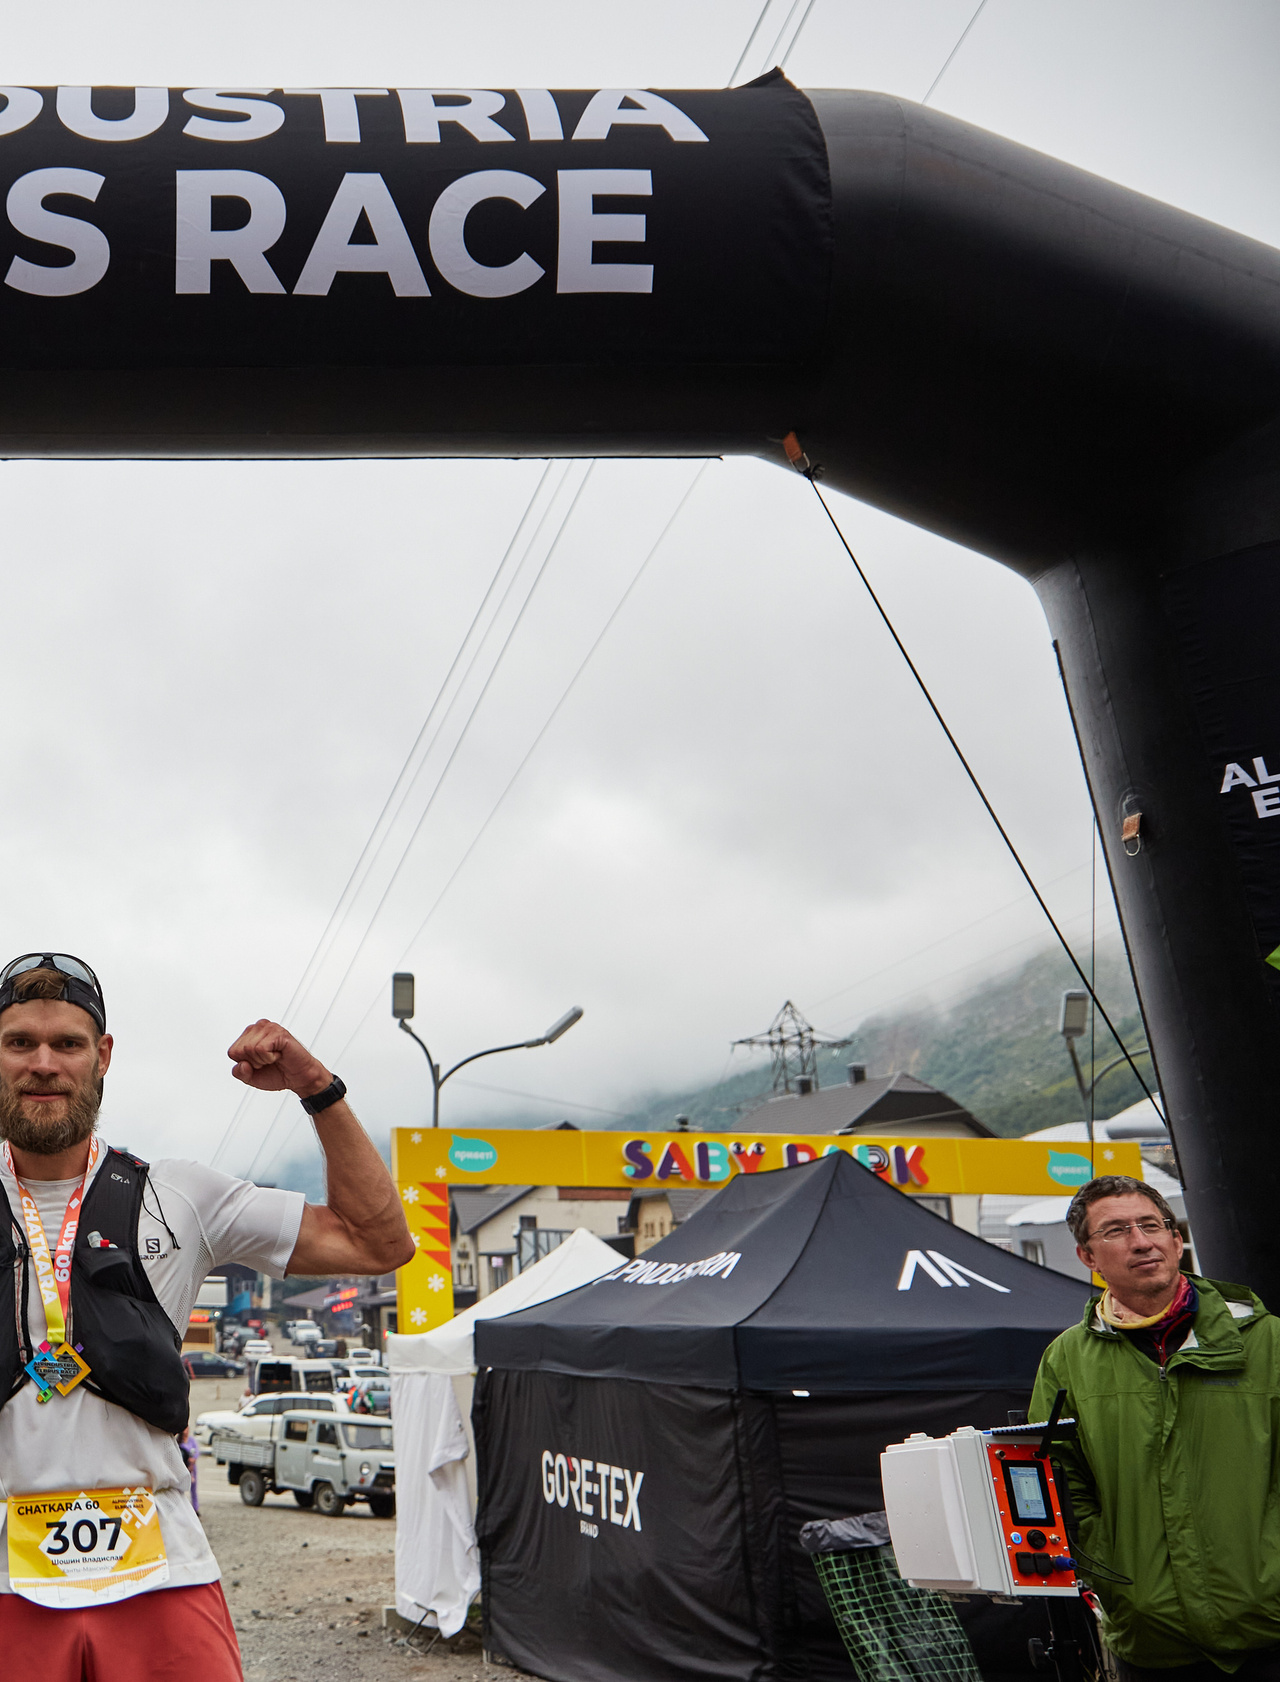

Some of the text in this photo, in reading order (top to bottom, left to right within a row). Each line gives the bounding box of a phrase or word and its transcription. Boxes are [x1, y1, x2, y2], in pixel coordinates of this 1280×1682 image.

[175, 168, 655, 298] RACE
[1220, 756, 1280, 793] AL
[622, 1140, 930, 1185] SABY PRK
[21, 1195, 58, 1305] CHATKARA
[54, 1220, 78, 1283] 60 km
[17, 1500, 100, 1516] CHATKARA 60
[542, 1450, 645, 1532] GORE-TEX
[45, 1517, 122, 1555] 307
[51, 1555, 124, 1566] Шошин Владислав
